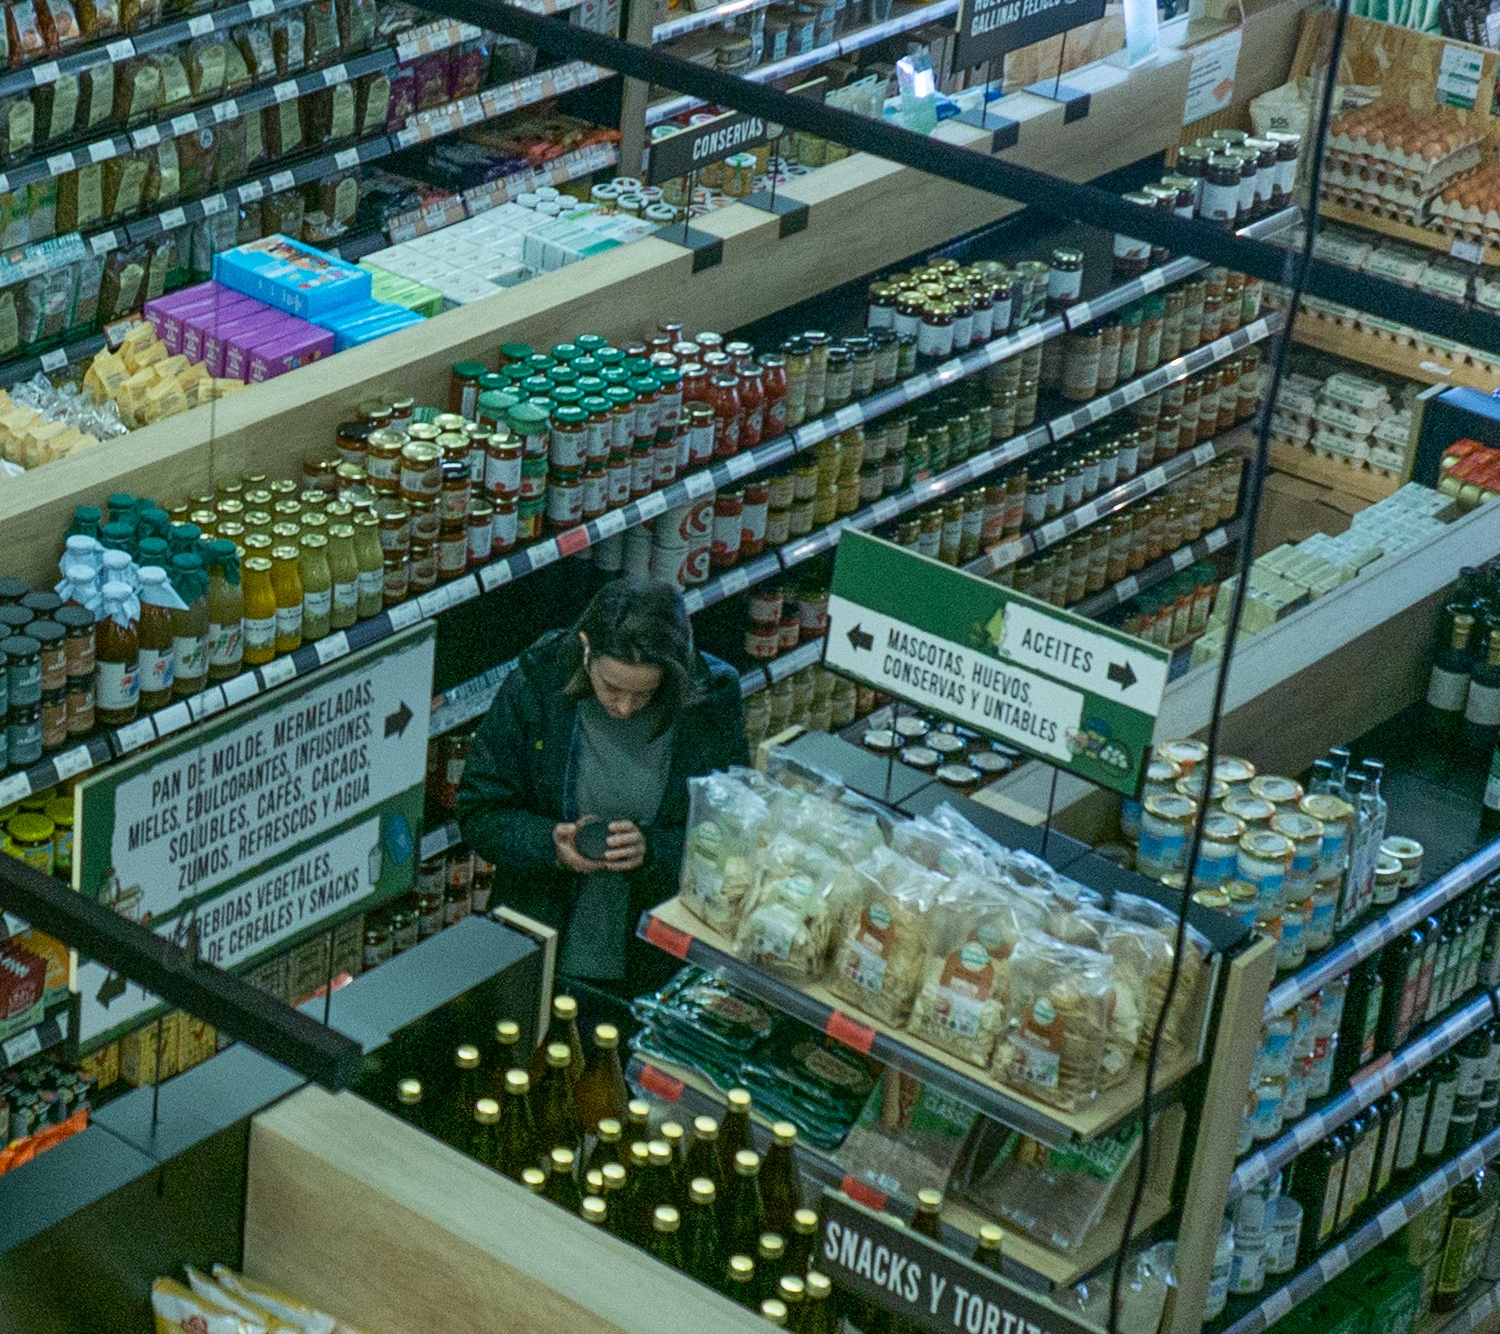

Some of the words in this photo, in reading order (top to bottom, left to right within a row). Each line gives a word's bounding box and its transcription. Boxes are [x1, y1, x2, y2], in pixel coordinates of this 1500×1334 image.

[692, 116, 763, 161] CONSERVAS
[887, 628, 967, 680] MASCOTAS,
[972, 661, 1033, 707] HUEVOS,
[1021, 627, 1094, 674] ACEITES
[152, 771, 181, 808] PAN
[187, 758, 206, 790] DE
[212, 730, 268, 779] MOLDE,
[273, 679, 375, 749] MERMELADAS,
[882, 654, 966, 706] CONSERVAS
[970, 688, 978, 710] Y
[983, 696, 1058, 744] UNTABLES
[128, 808, 182, 852] MIELES,
[186, 753, 289, 824] EDULCORANTES,
[295, 712, 374, 767] INFUSIONES,
[168, 803, 251, 865] SOLUBLES,
[257, 771, 302, 820] CAFÉS,
[311, 744, 370, 793] CACAOS,
[177, 844, 233, 893] ZUMOS,
[238, 799, 318, 862] REFRESCOS
[322, 795, 330, 817] Y
[335, 773, 370, 808] AGUA
[256, 853, 335, 906] VEGETALES,
[206, 938, 225, 965] DE
[228, 905, 293, 957] CEREALES
[298, 896, 307, 918] Y
[309, 867, 361, 914] SNACKS
[823, 1219, 922, 1304] SNACKS
[930, 1273, 947, 1314] Y
